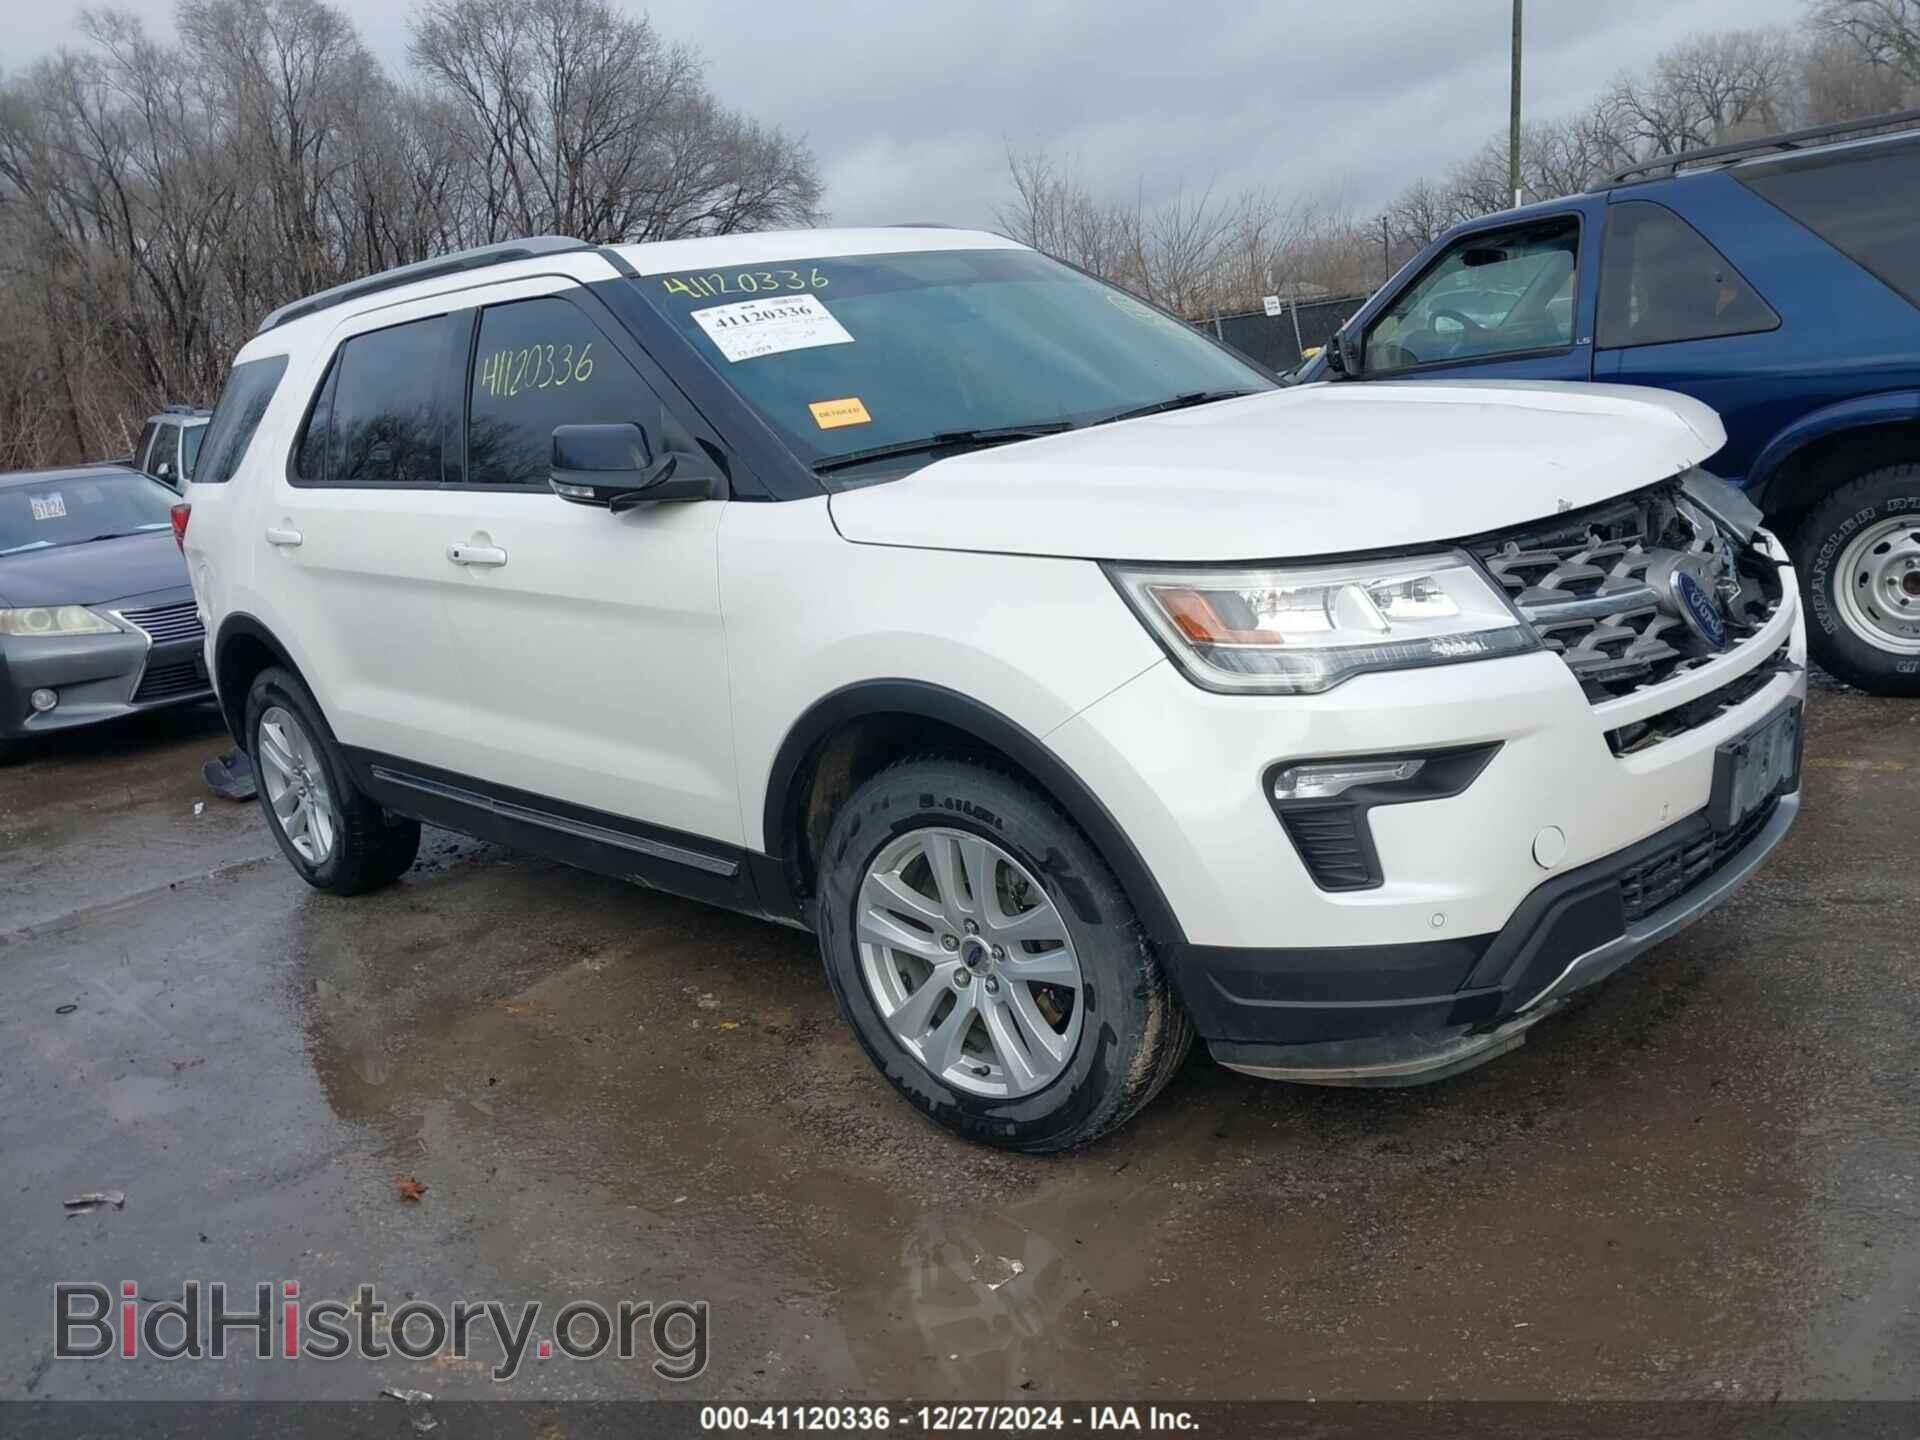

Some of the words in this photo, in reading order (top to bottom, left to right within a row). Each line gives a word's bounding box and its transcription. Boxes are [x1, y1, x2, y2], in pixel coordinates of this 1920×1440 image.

[662, 267, 830, 298] 41120336
[716, 305, 813, 329] 41120336
[481, 343, 593, 397] 41120336
